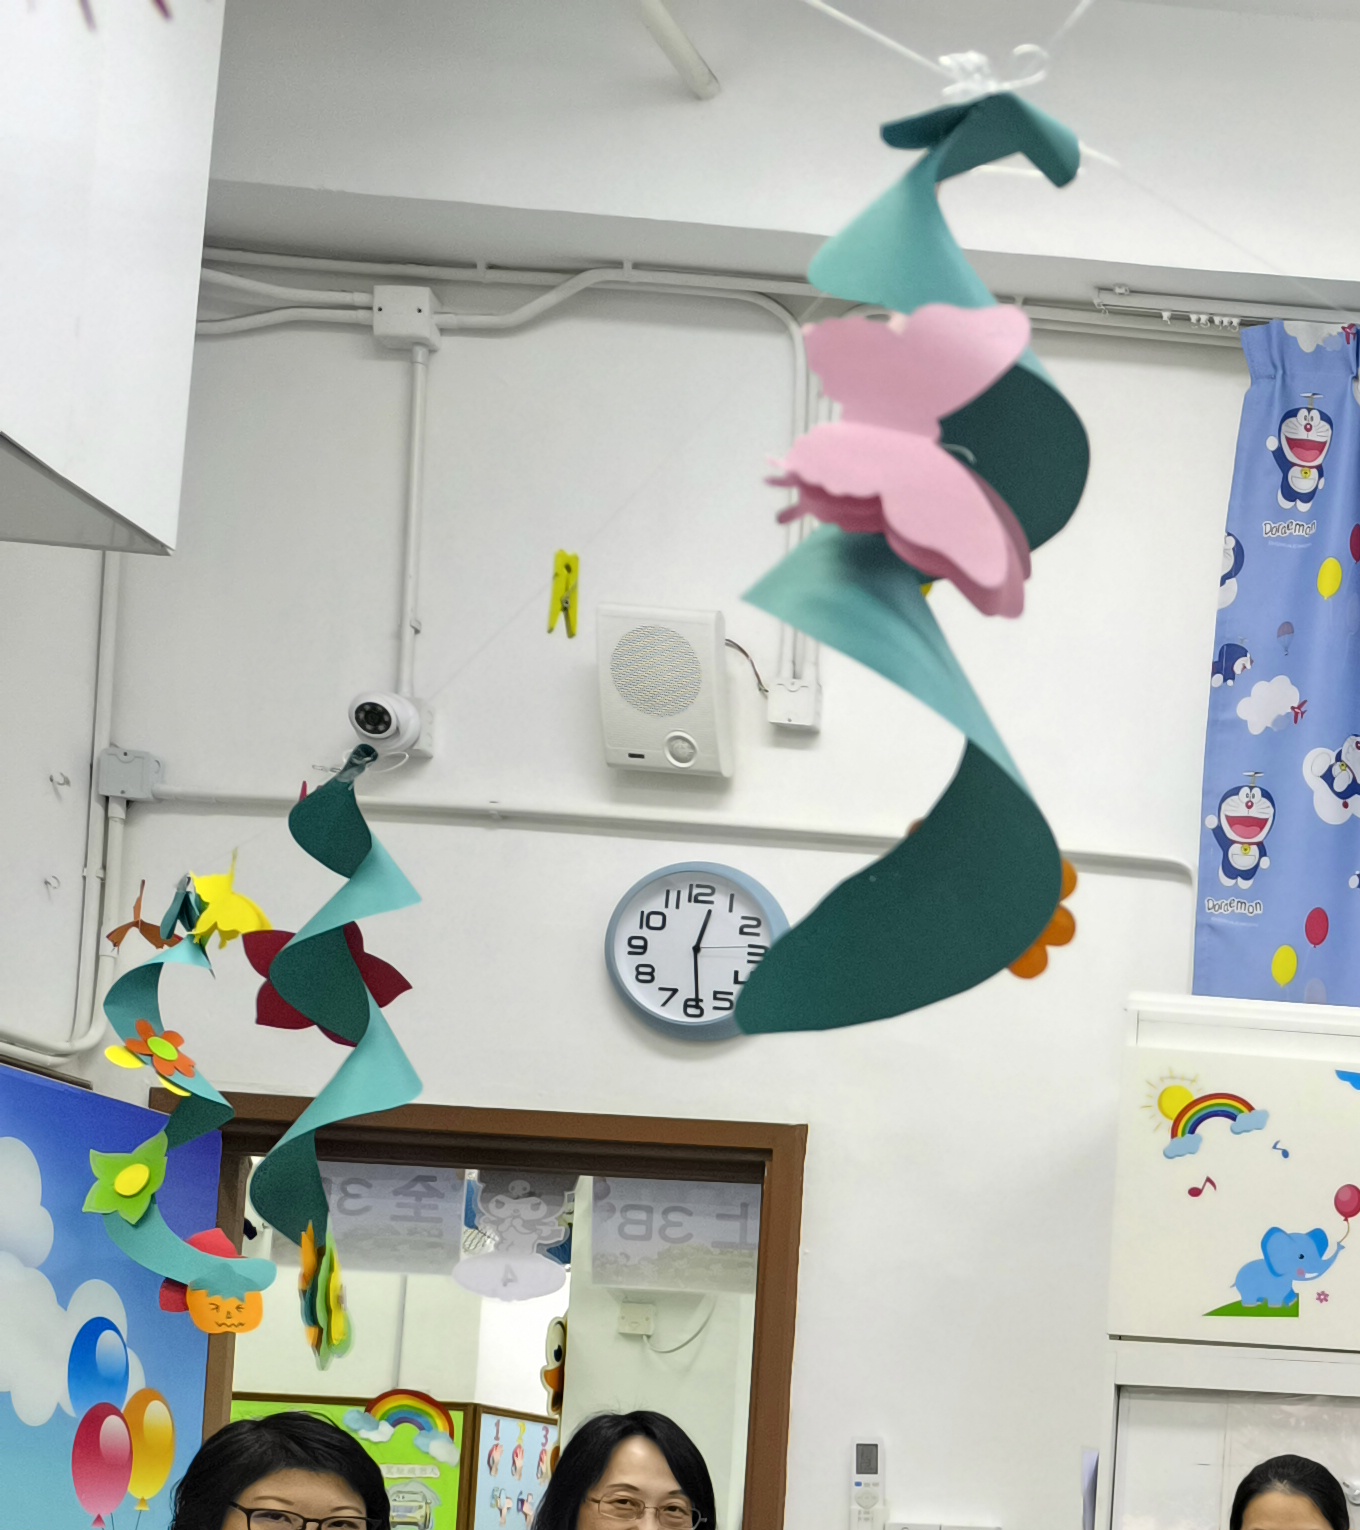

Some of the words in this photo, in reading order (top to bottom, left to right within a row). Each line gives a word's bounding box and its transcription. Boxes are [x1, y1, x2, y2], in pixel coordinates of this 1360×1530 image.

[1263, 520, 1316, 537] Doraemon
[688, 884, 716, 904] 12
[728, 893, 734, 912] 1
[1206, 898, 1263, 916] Doraemon
[639, 911, 666, 930] 10
[739, 916, 761, 936] 2
[627, 936, 648, 955] 9
[635, 964, 655, 983] 8
[658, 987, 679, 1007] 7
[712, 991, 733, 1010] 5
[683, 998, 704, 1018] 6
